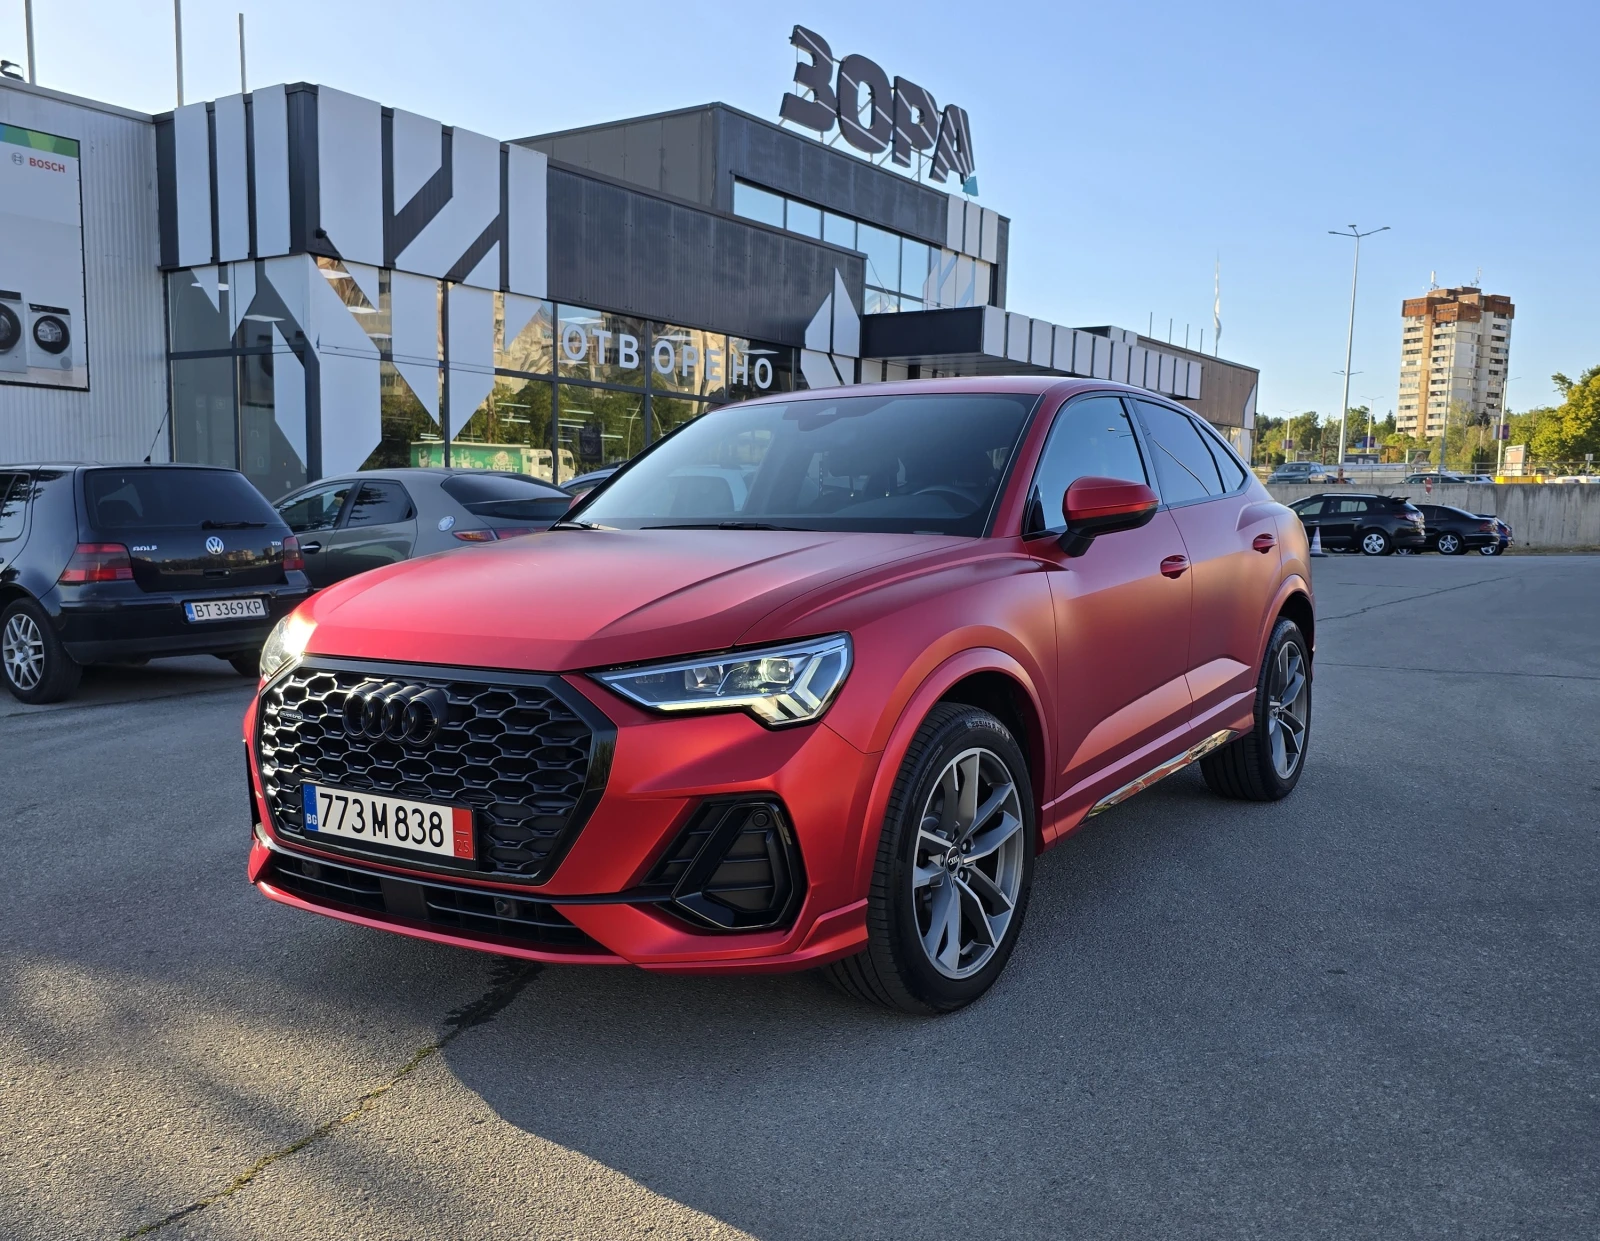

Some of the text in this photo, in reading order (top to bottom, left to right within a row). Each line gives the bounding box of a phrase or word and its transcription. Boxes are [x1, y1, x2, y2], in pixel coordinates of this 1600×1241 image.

[778, 24, 976, 186] ЗОРА
[29, 157, 66, 173] BOSCH
[215, 602, 245, 617] 3369
[306, 813, 318, 825] BG
[456, 839, 470, 853] 25
